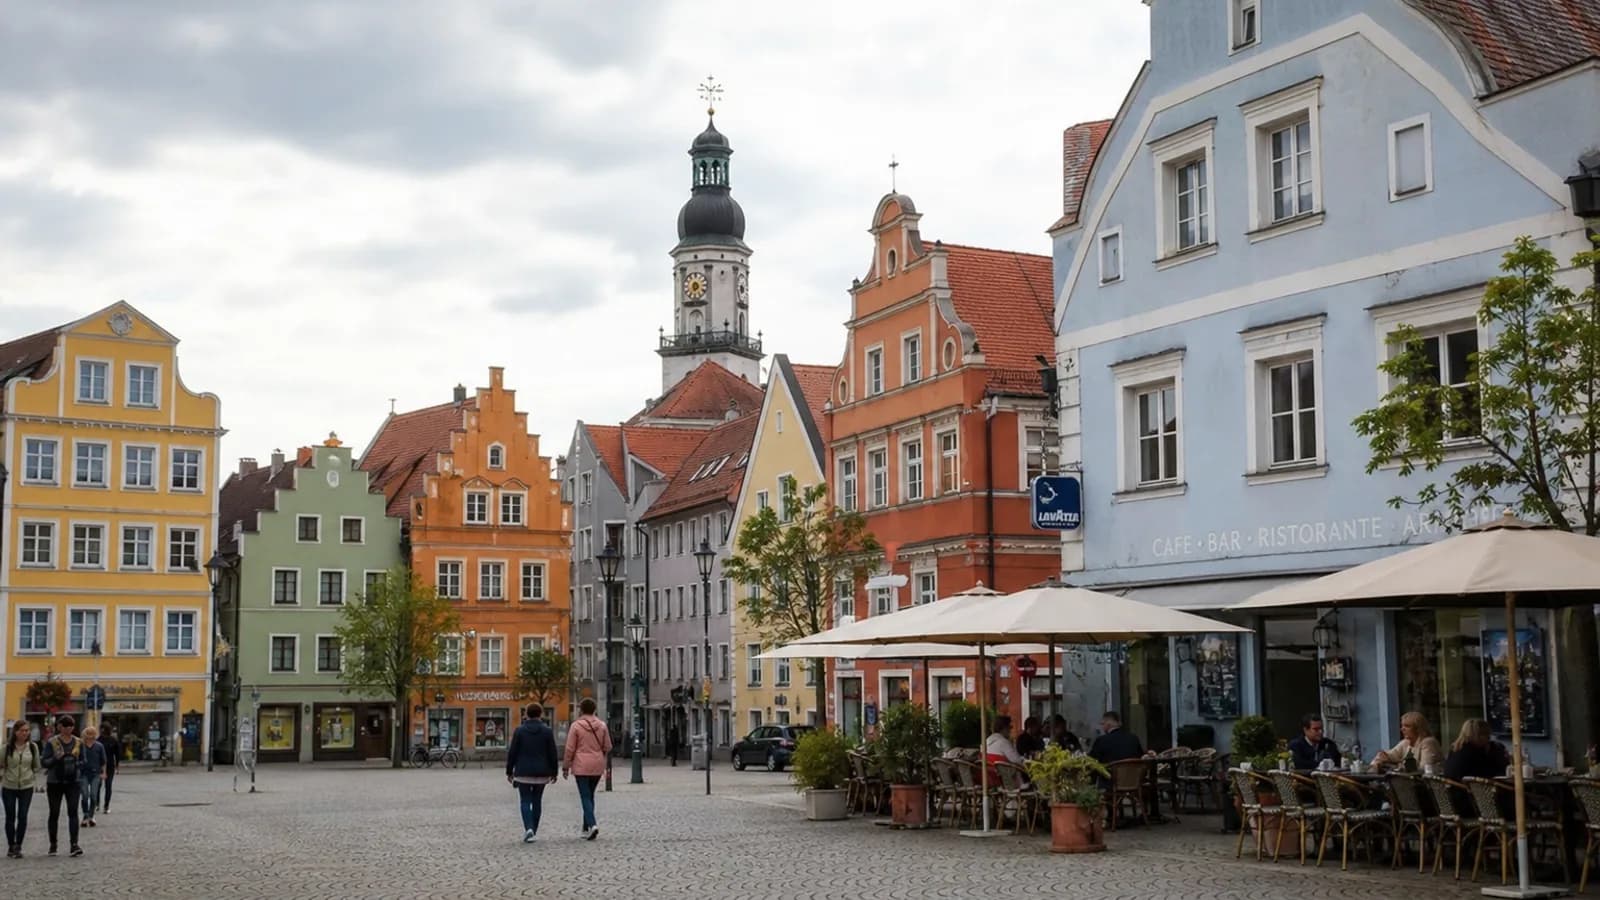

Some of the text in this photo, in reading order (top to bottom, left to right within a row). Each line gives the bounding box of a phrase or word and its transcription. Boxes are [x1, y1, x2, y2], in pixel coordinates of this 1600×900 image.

[1152, 535, 1192, 557] CAFE
[1208, 530, 1241, 552] BAR
[1258, 516, 1383, 547] RISTORANTE
